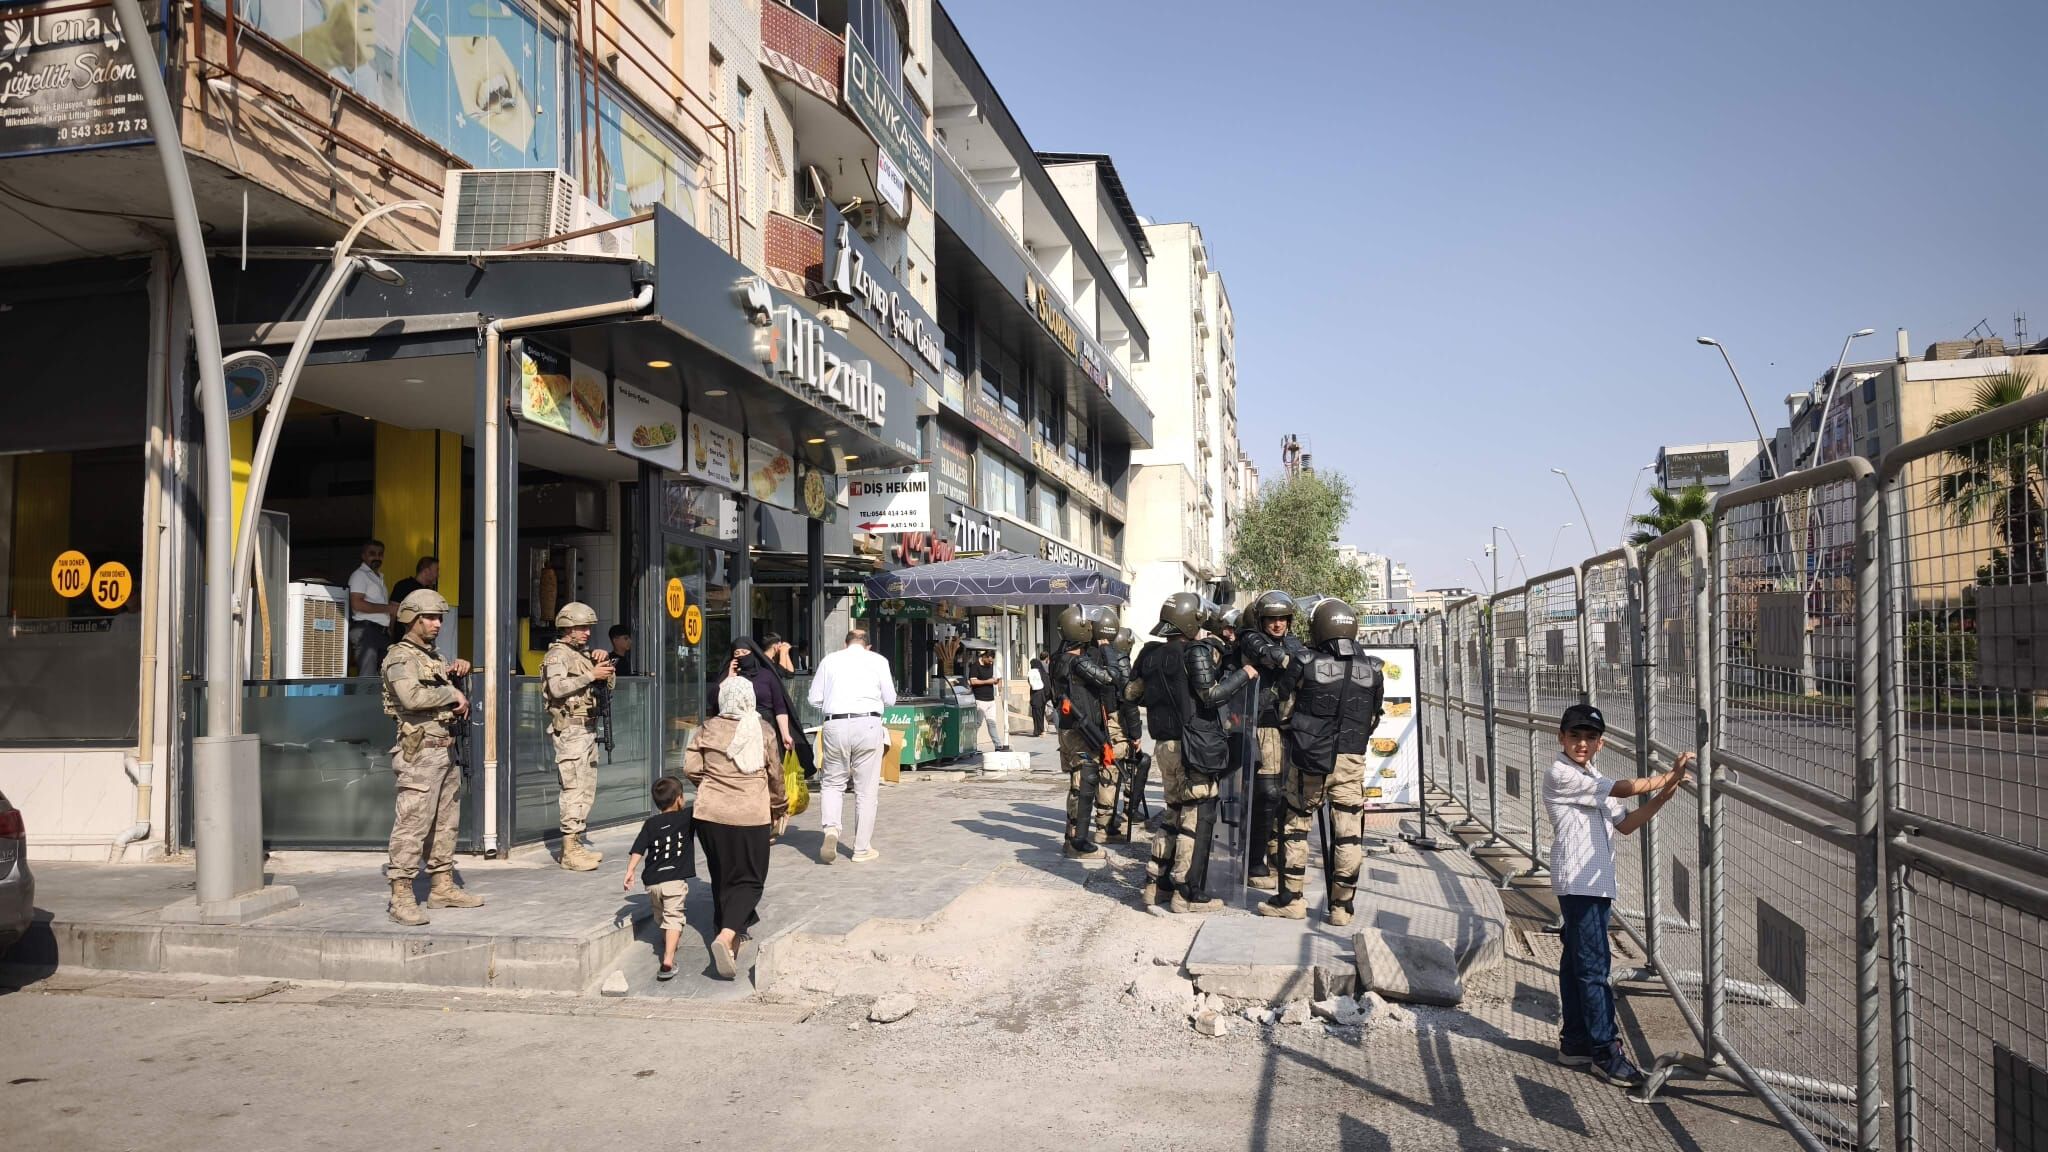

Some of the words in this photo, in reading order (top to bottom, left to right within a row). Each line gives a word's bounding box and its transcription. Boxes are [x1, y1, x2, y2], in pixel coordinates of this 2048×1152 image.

[71, 125, 91, 138] 543
[94, 122, 114, 136] 332
[117, 120, 131, 133] 73
[134, 118, 148, 131] 73
[863, 480, 883, 497] DİŞ
[886, 478, 927, 494] HEKİMİ
[57, 568, 80, 591] 100
[98, 580, 119, 602] 50
[688, 618, 697, 637] 50
